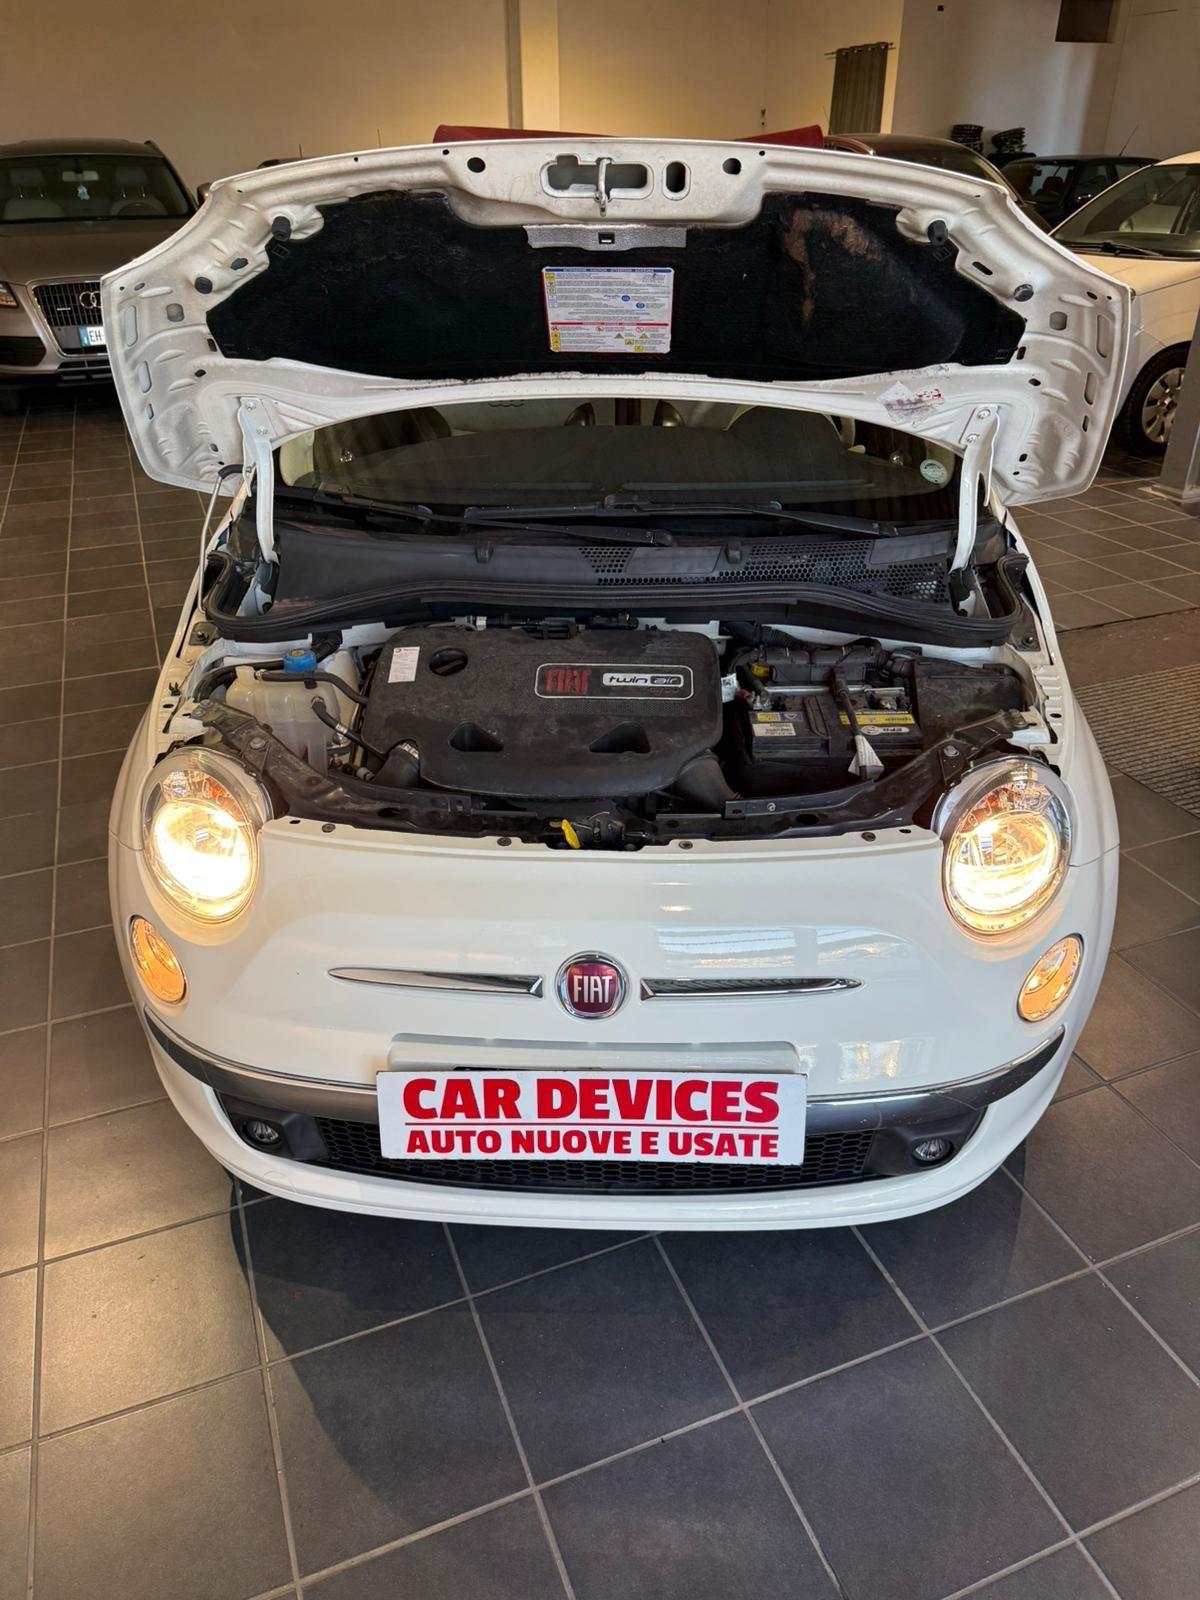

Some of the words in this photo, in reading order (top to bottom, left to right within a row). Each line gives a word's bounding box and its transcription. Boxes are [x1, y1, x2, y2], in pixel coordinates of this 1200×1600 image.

[608, 675, 648, 683] twin
[653, 677, 678, 685] air
[573, 975, 613, 1004] FIAT
[403, 1078, 522, 1119] CAR
[536, 1078, 780, 1123] DEVICES
[407, 1130, 502, 1154] AUTO
[511, 1130, 632, 1154] NUOVE
[641, 1131, 659, 1154] E
[668, 1132, 779, 1158] USATE
